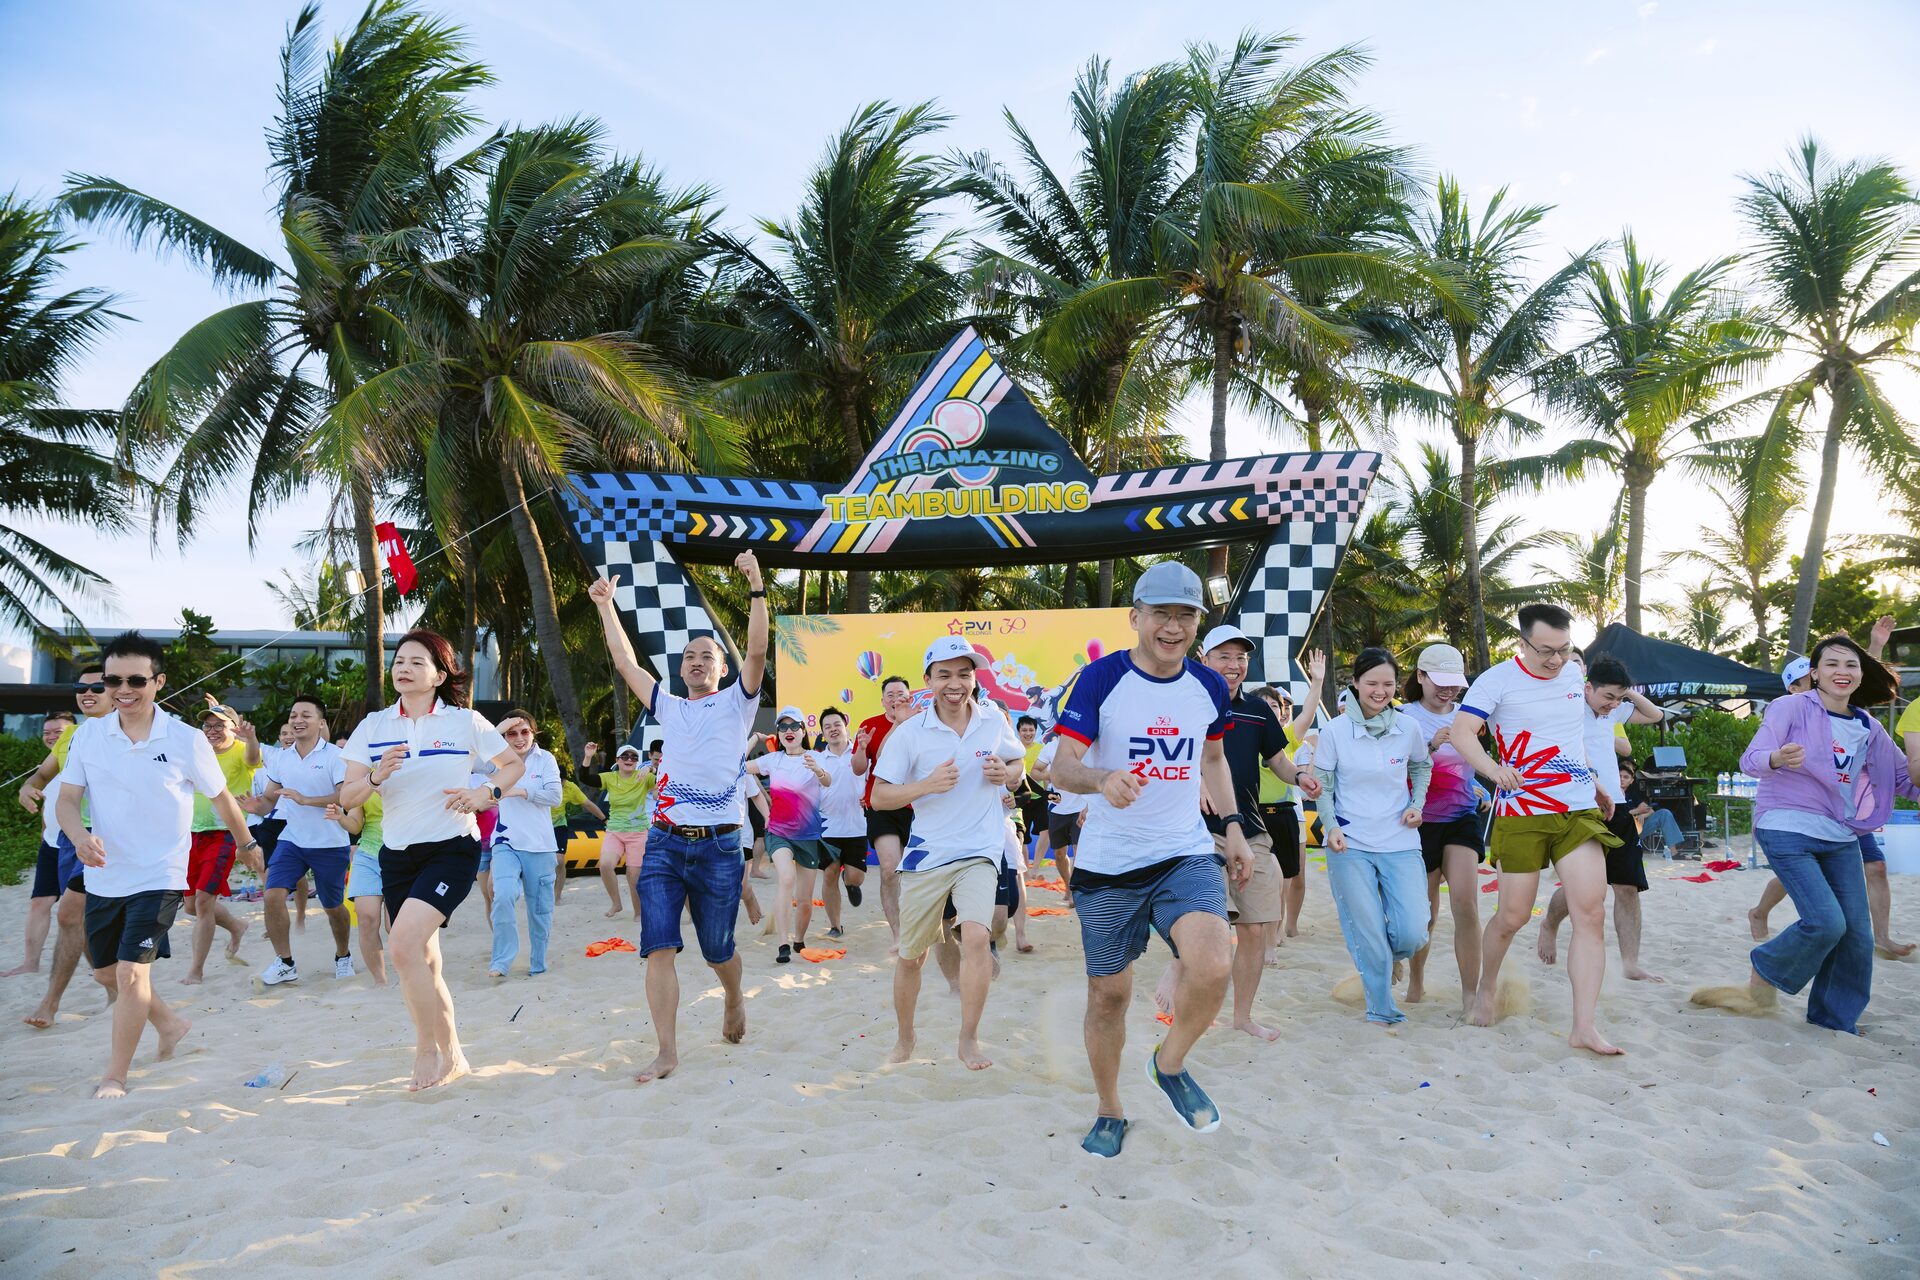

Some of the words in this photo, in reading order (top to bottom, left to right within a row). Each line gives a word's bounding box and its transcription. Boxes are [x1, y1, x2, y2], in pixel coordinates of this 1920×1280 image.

[873, 454, 922, 480] THE
[929, 450, 1059, 472] AMAZING
[825, 484, 1089, 522] TEAMBUILDING
[965, 621, 992, 631] PVI
[1128, 737, 1194, 761] PVI
[1833, 753, 1854, 770] VI
